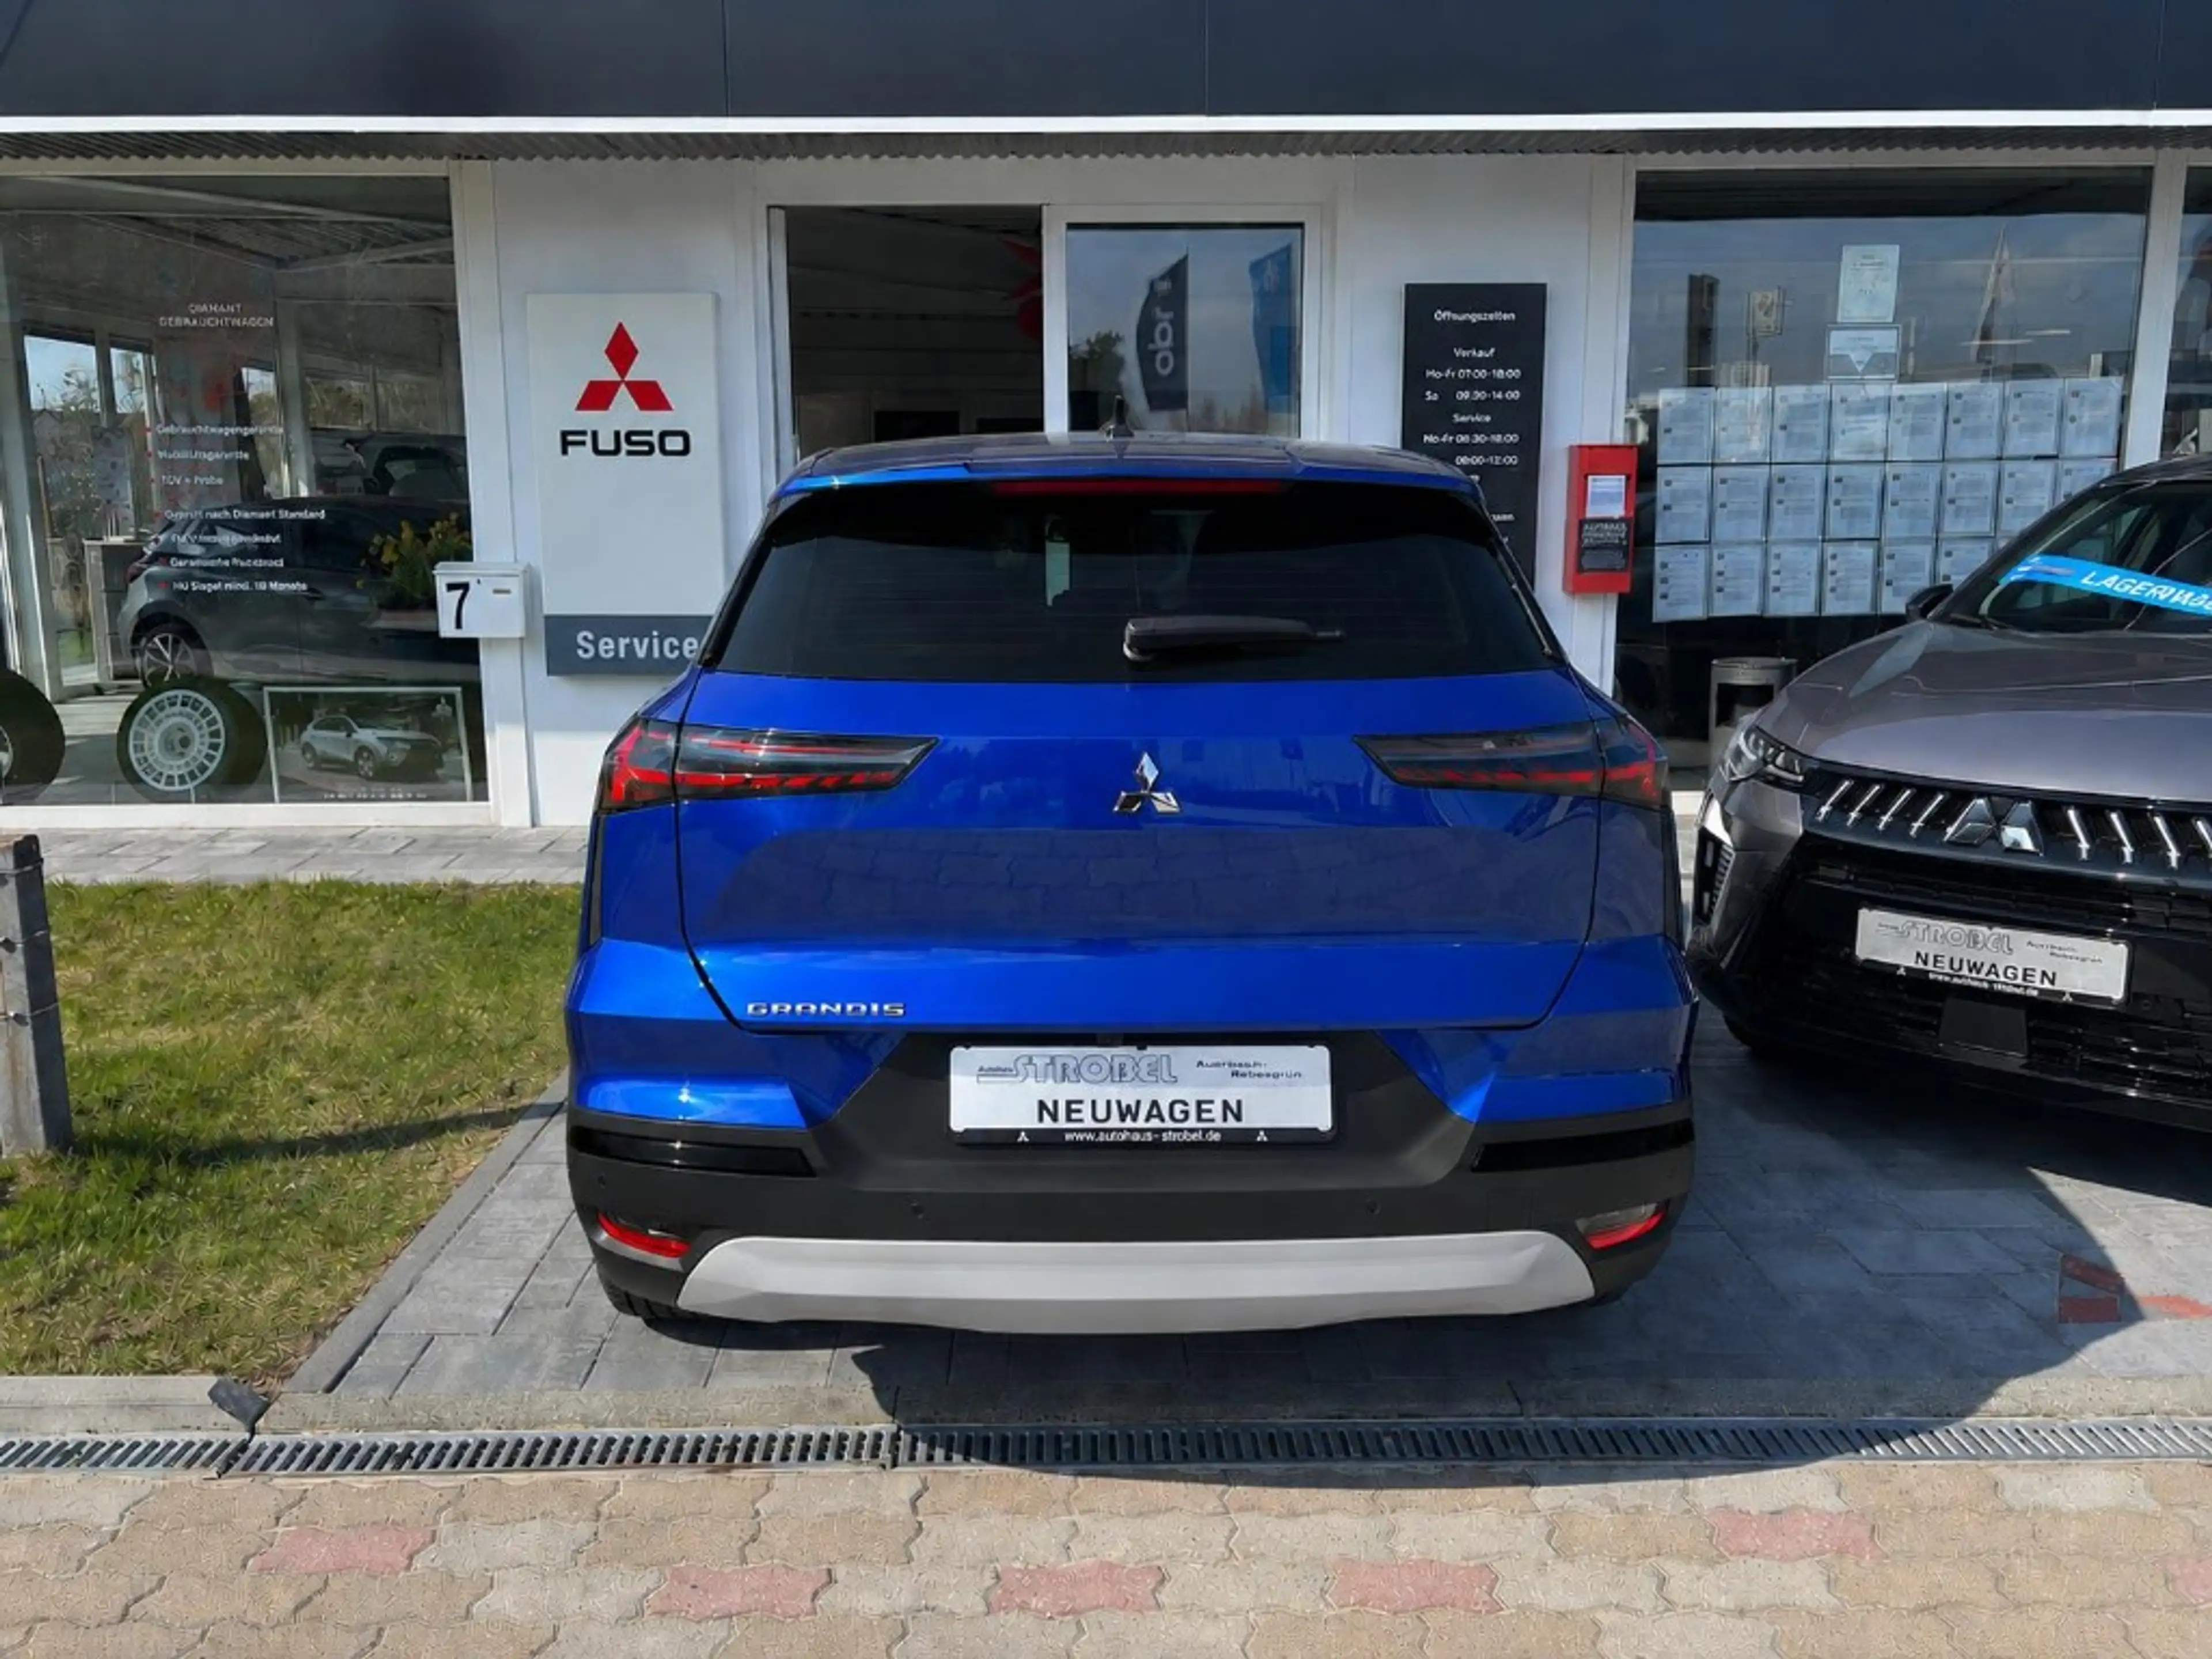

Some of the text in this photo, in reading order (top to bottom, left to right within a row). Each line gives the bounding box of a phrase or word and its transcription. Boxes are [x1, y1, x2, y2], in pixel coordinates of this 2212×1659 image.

[1453, 347, 1495, 358] Verkauf
[560, 429, 691, 457] FUSO
[279, 509, 325, 519] Standard
[446, 582, 469, 629] 7
[577, 630, 698, 660] Service
[1915, 950, 2056, 986] NEUWAGEN
[747, 1002, 904, 1016] GRANDIS
[1014, 1054, 1179, 1084] STROBEL
[1037, 1099, 1243, 1124] NEUWAGEN
